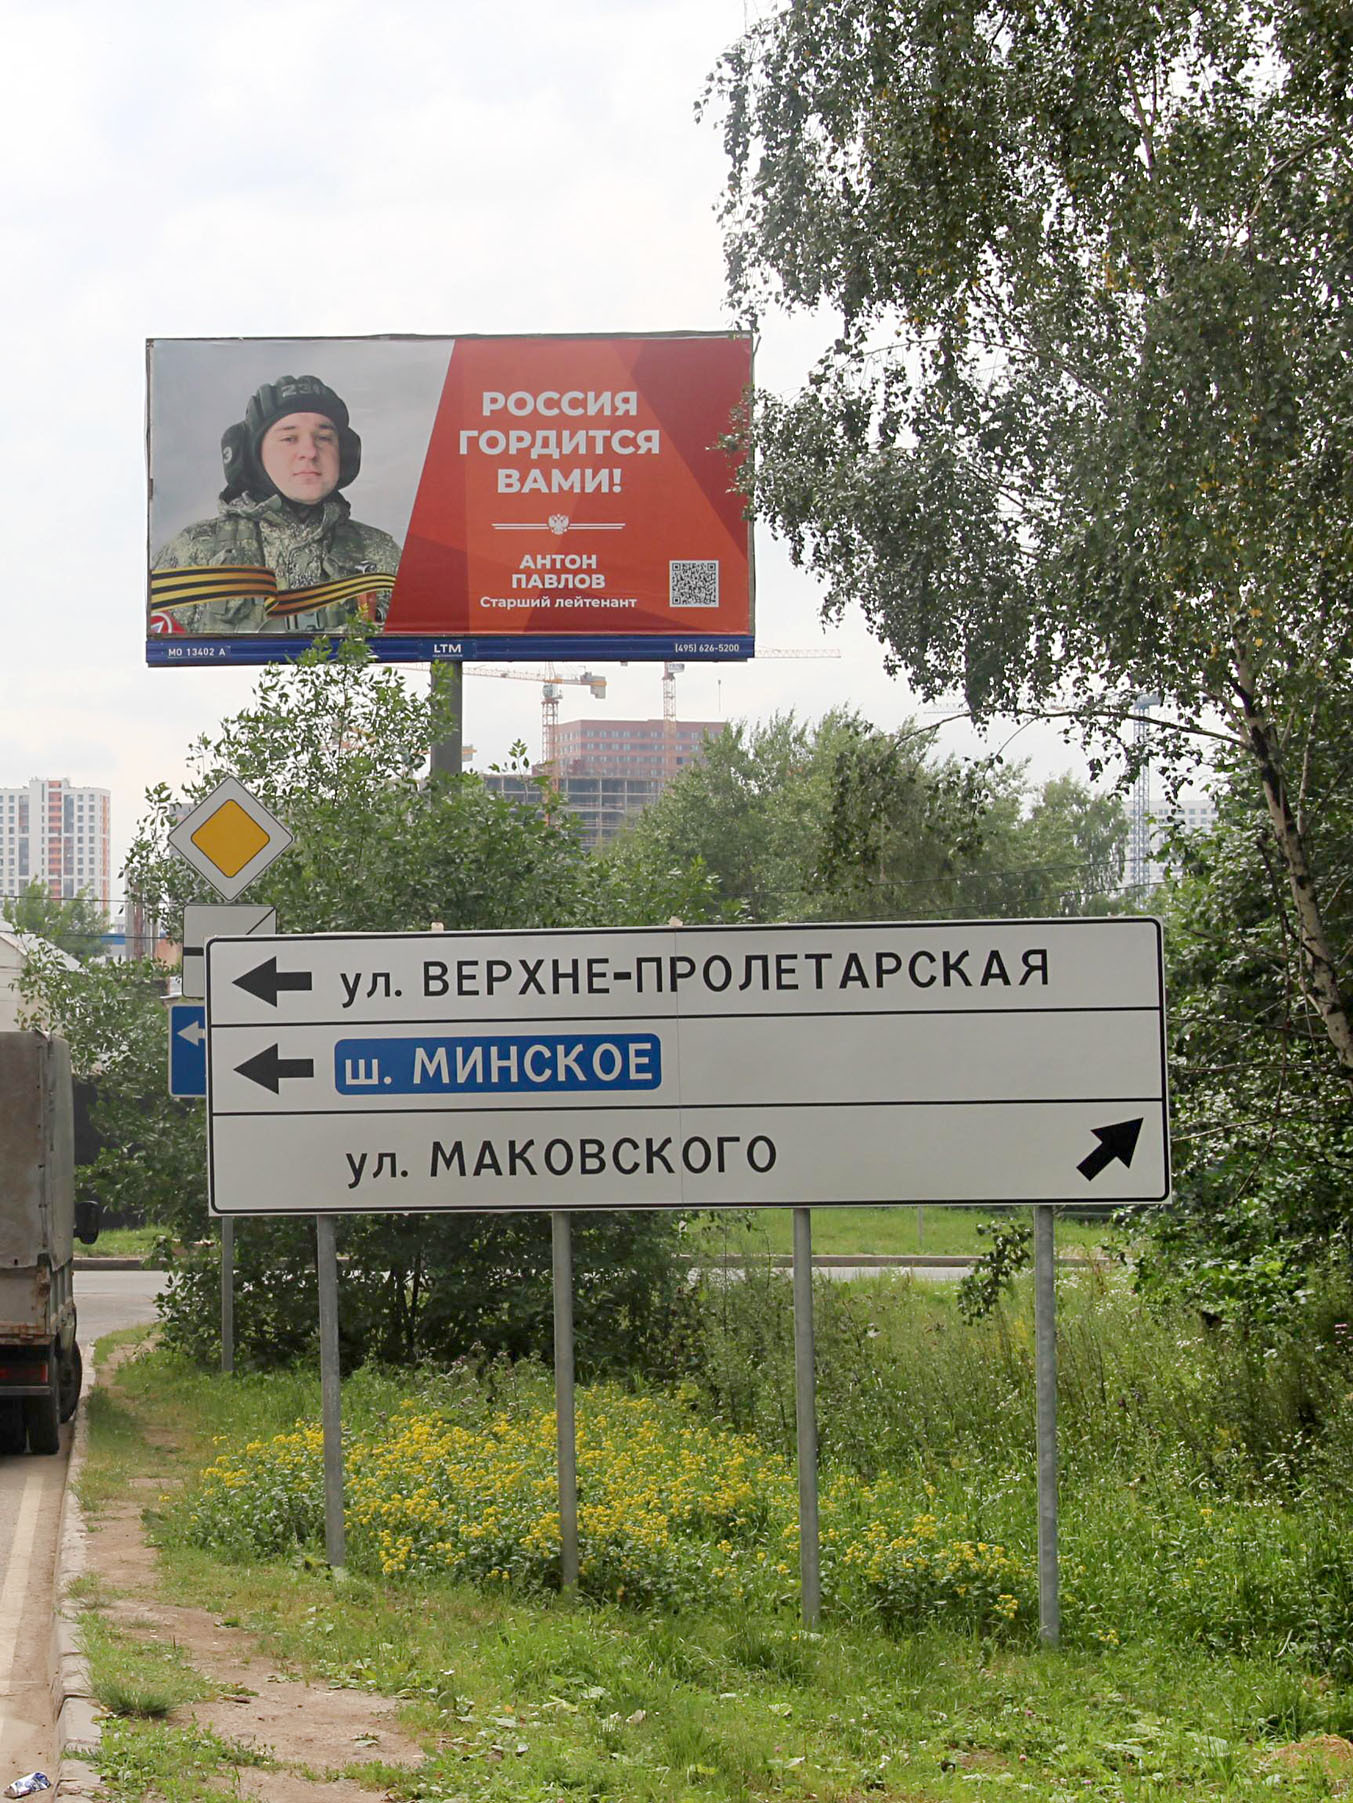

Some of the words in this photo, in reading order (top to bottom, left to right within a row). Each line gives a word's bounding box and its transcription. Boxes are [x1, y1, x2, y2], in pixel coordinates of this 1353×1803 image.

[482, 391, 638, 417] РОССИЯ
[459, 429, 660, 460] ГОРДИТСЯ
[497, 468, 623, 494] ВАМИ!
[519, 554, 597, 569] АНТОН
[511, 573, 606, 589] ПАВЛОВ
[480, 596, 551, 610] Старший
[554, 596, 637, 608] лейтенант
[168, 648, 183, 657] МО
[186, 648, 215, 657] 13402
[433, 643, 462, 653] LTM
[675, 643, 697, 653] (495)
[699, 643, 740, 653] 626-5200
[340, 972, 403, 1009] ул.
[423, 948, 1050, 997] ВЕРХНЕ-ПРОЛЕТАРСКАЯ
[345, 1058, 393, 1086] ш.
[413, 1042, 653, 1085] МИНСКОЕ
[346, 1153, 409, 1190] ул.
[430, 1135, 777, 1178] МАКОВСКОГО
